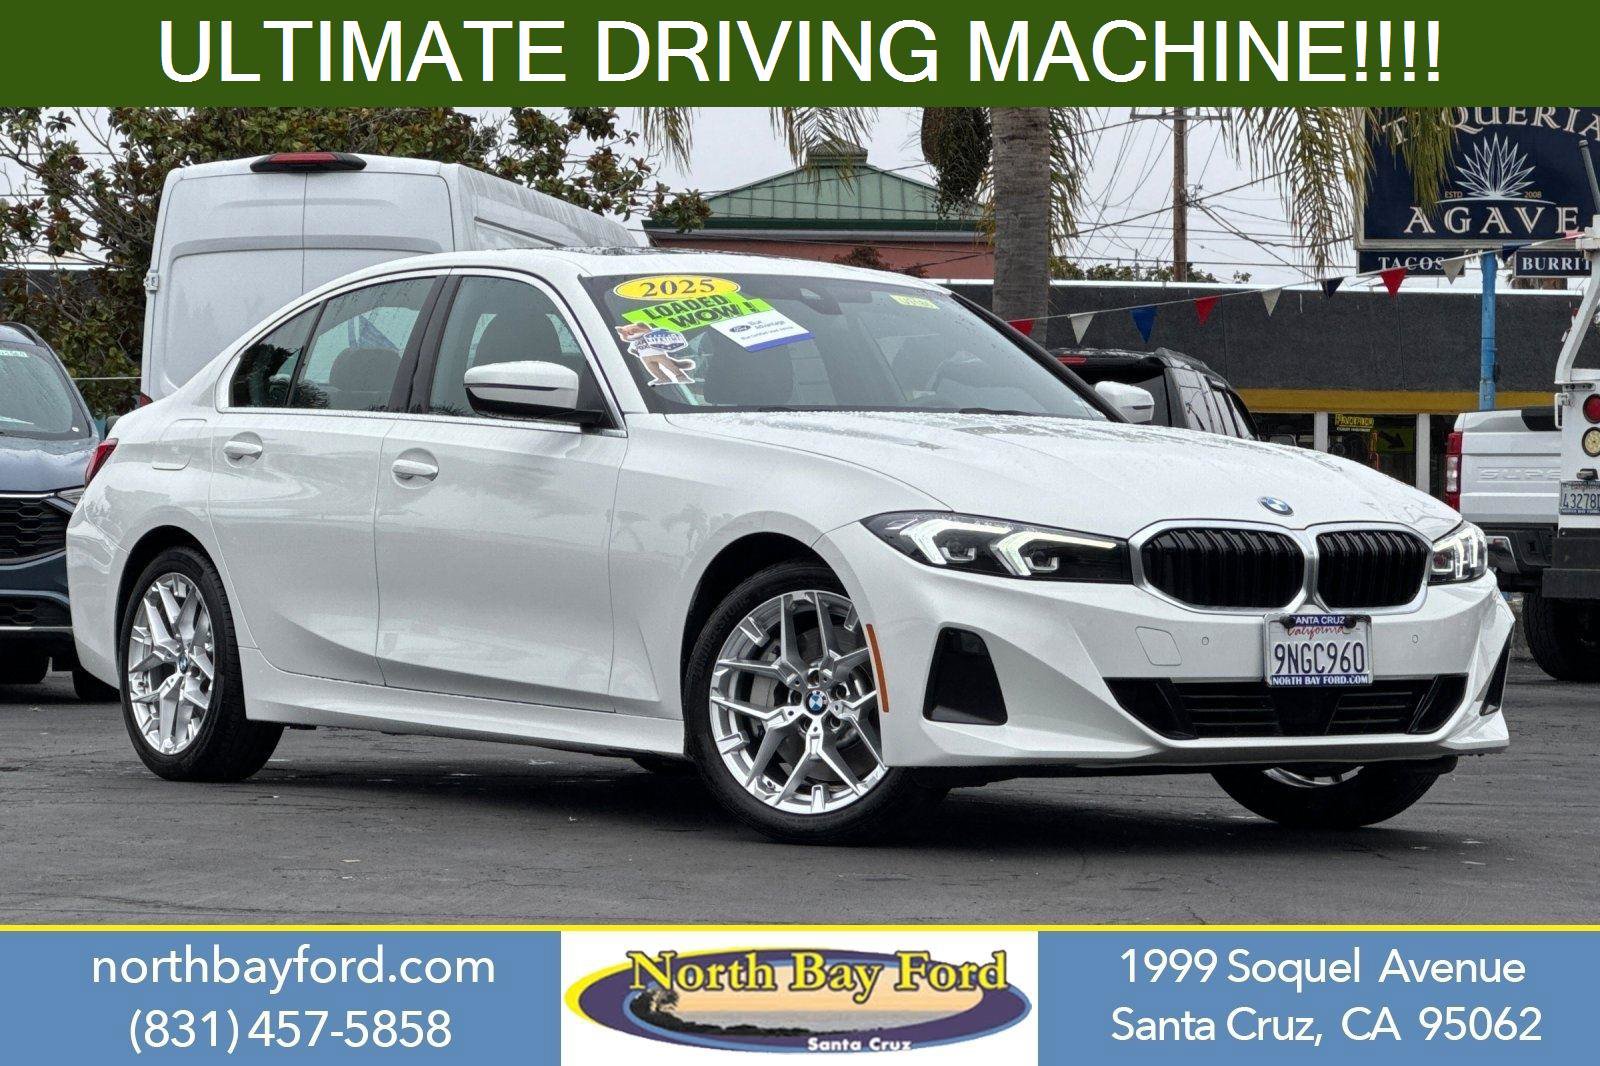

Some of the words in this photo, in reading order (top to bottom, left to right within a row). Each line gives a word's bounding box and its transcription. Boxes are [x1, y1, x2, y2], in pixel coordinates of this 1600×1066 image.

[1382, 107, 1600, 145] TQUERIA
[1444, 190, 1463, 199] ESTD
[1524, 190, 1542, 199] 2008
[1403, 207, 1579, 234] AGAVE
[1378, 256, 1445, 271] TACOS
[639, 279, 715, 297] 2025
[642, 294, 729, 320] LOADED
[667, 303, 741, 328] WOW
[1293, 616, 1320, 625] ANTA
[1320, 616, 1346, 625] CRUZ
[1287, 626, 1345, 640] California
[1274, 642, 1365, 674] 9NGC960
[1272, 676, 1303, 685] NORTH
[1305, 676, 1321, 685] BAY
[1323, 675, 1368, 684] FORD.COM
